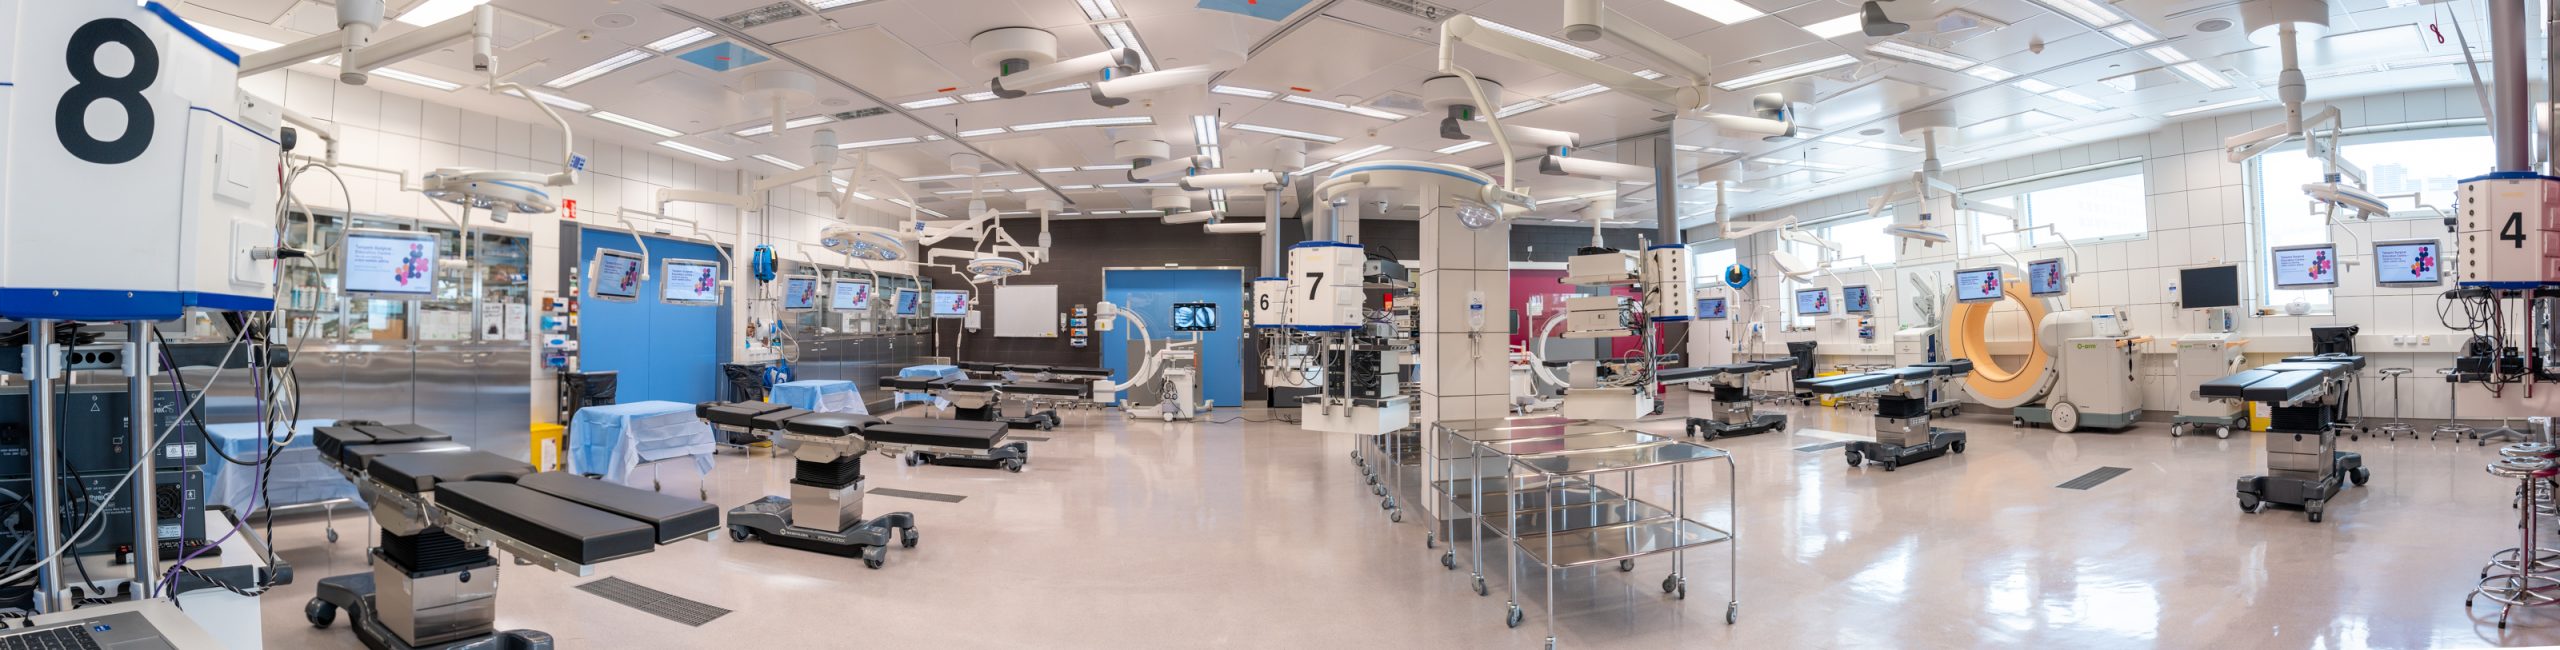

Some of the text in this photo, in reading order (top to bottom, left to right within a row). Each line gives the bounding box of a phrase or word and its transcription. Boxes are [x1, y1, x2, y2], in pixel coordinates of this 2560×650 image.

[55, 17, 159, 165] 8
[2500, 212, 2526, 248] 4
[1260, 294, 1269, 310] 6
[1306, 272, 1324, 300] 7
